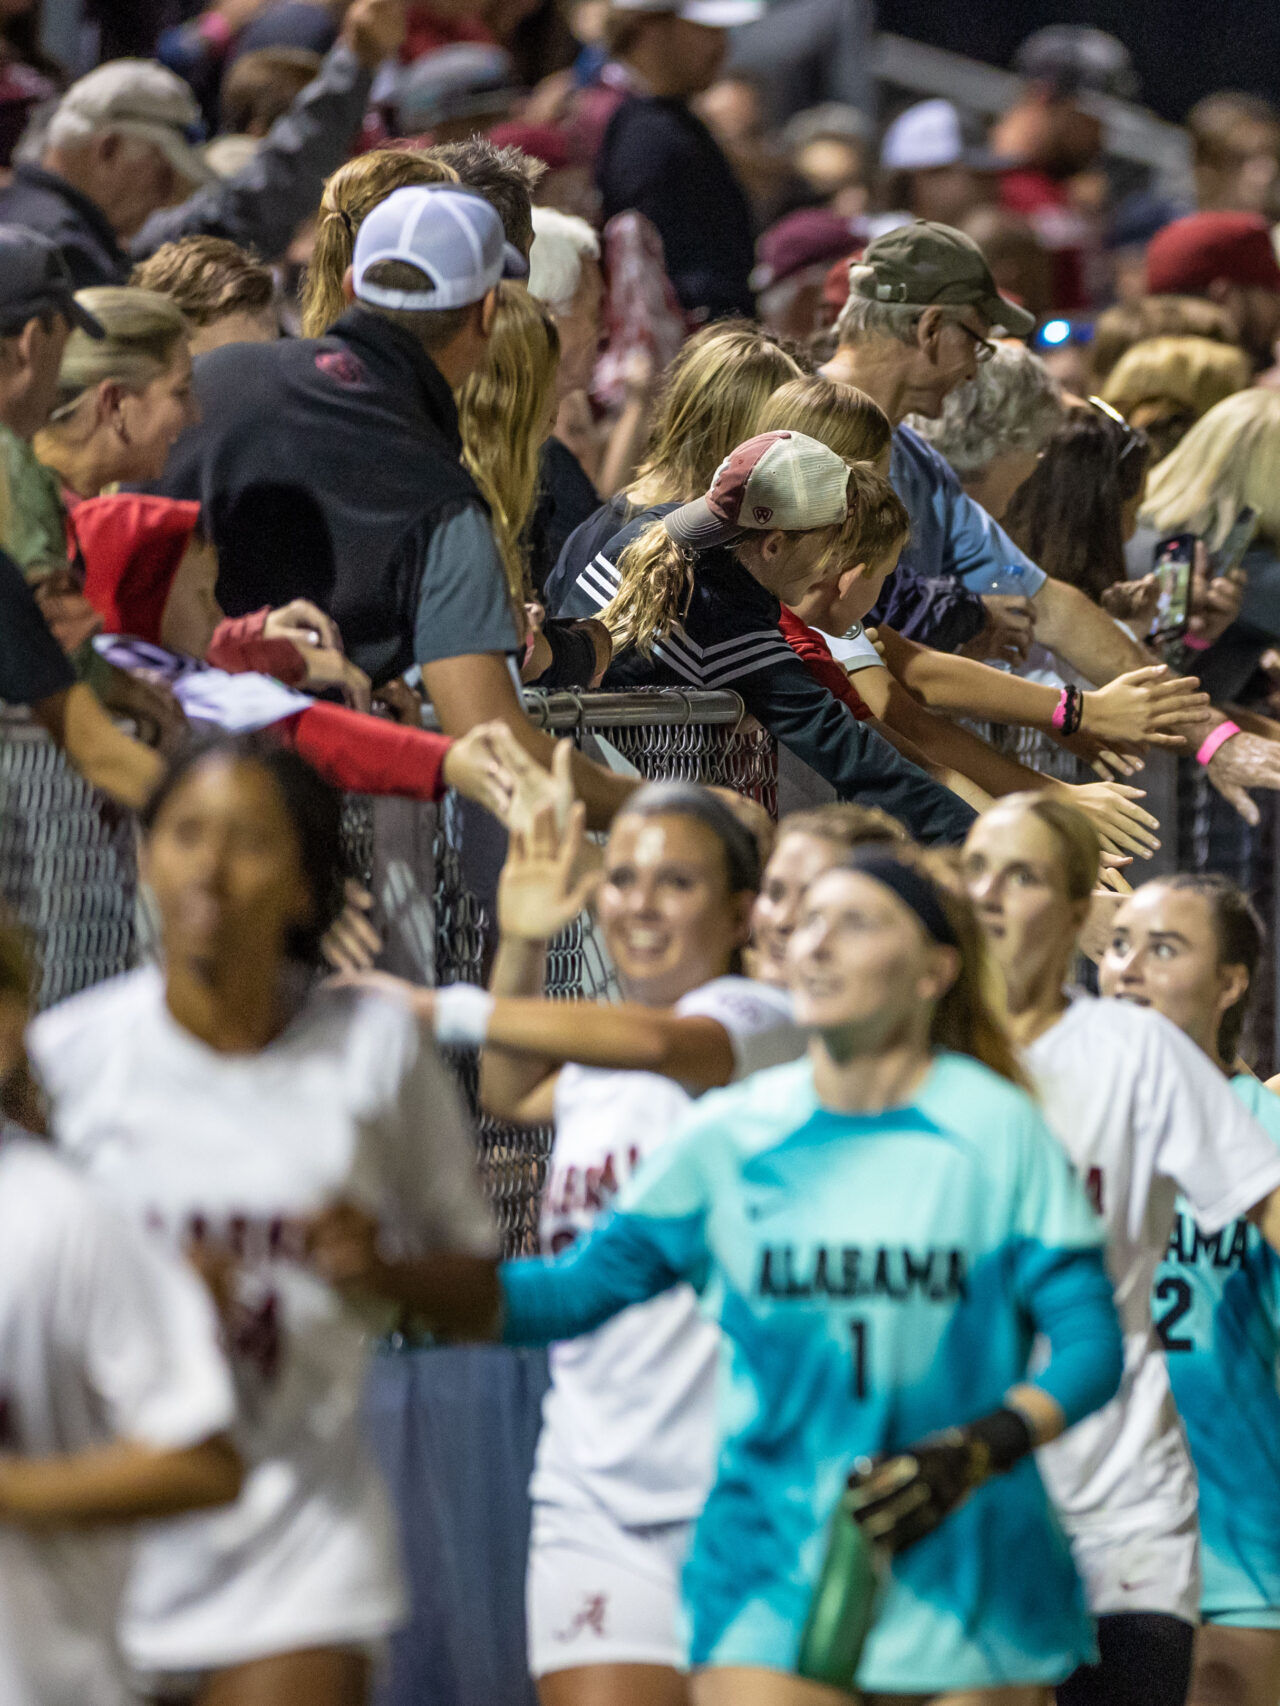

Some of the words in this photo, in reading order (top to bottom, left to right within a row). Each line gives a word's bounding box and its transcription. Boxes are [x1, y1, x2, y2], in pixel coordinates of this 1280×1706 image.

[759, 1247, 971, 1303] ALABAMA
[1157, 1277, 1193, 1352] 2
[850, 1320, 868, 1399] 1
